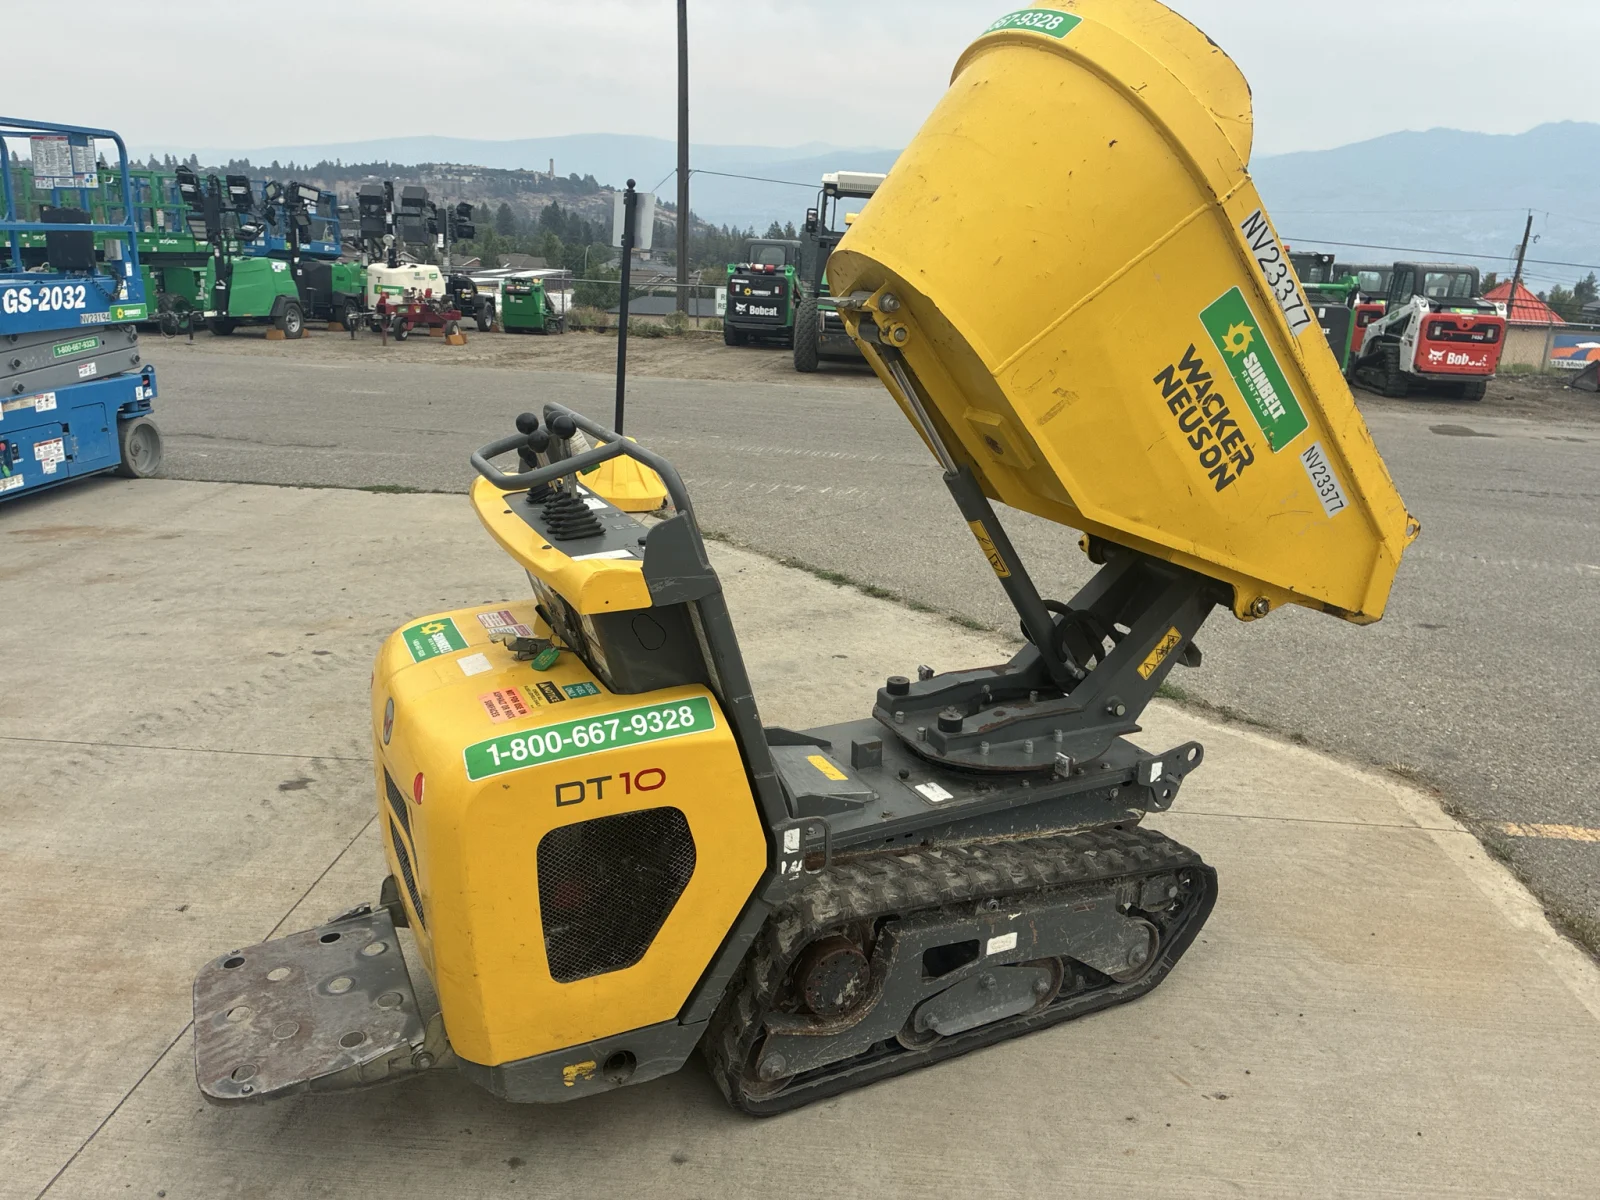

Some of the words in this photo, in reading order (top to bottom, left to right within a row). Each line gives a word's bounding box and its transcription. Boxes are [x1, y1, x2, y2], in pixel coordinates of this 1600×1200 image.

[3, 285, 86, 314] GS-2032
[1241, 209, 1312, 328] NV23377
[749, 305, 777, 316] Bobcat
[1177, 343, 1255, 476] WACKER
[1241, 370, 1269, 418] RENTALS
[1242, 351, 1286, 420] SUNBELT
[1153, 363, 1237, 492] NEUSON
[1302, 445, 1344, 513] NV23377
[543, 686, 561, 703] NOTICE
[486, 705, 695, 767] 1-800-667-9328
[555, 775, 612, 807] DT
[619, 767, 666, 794] 10
